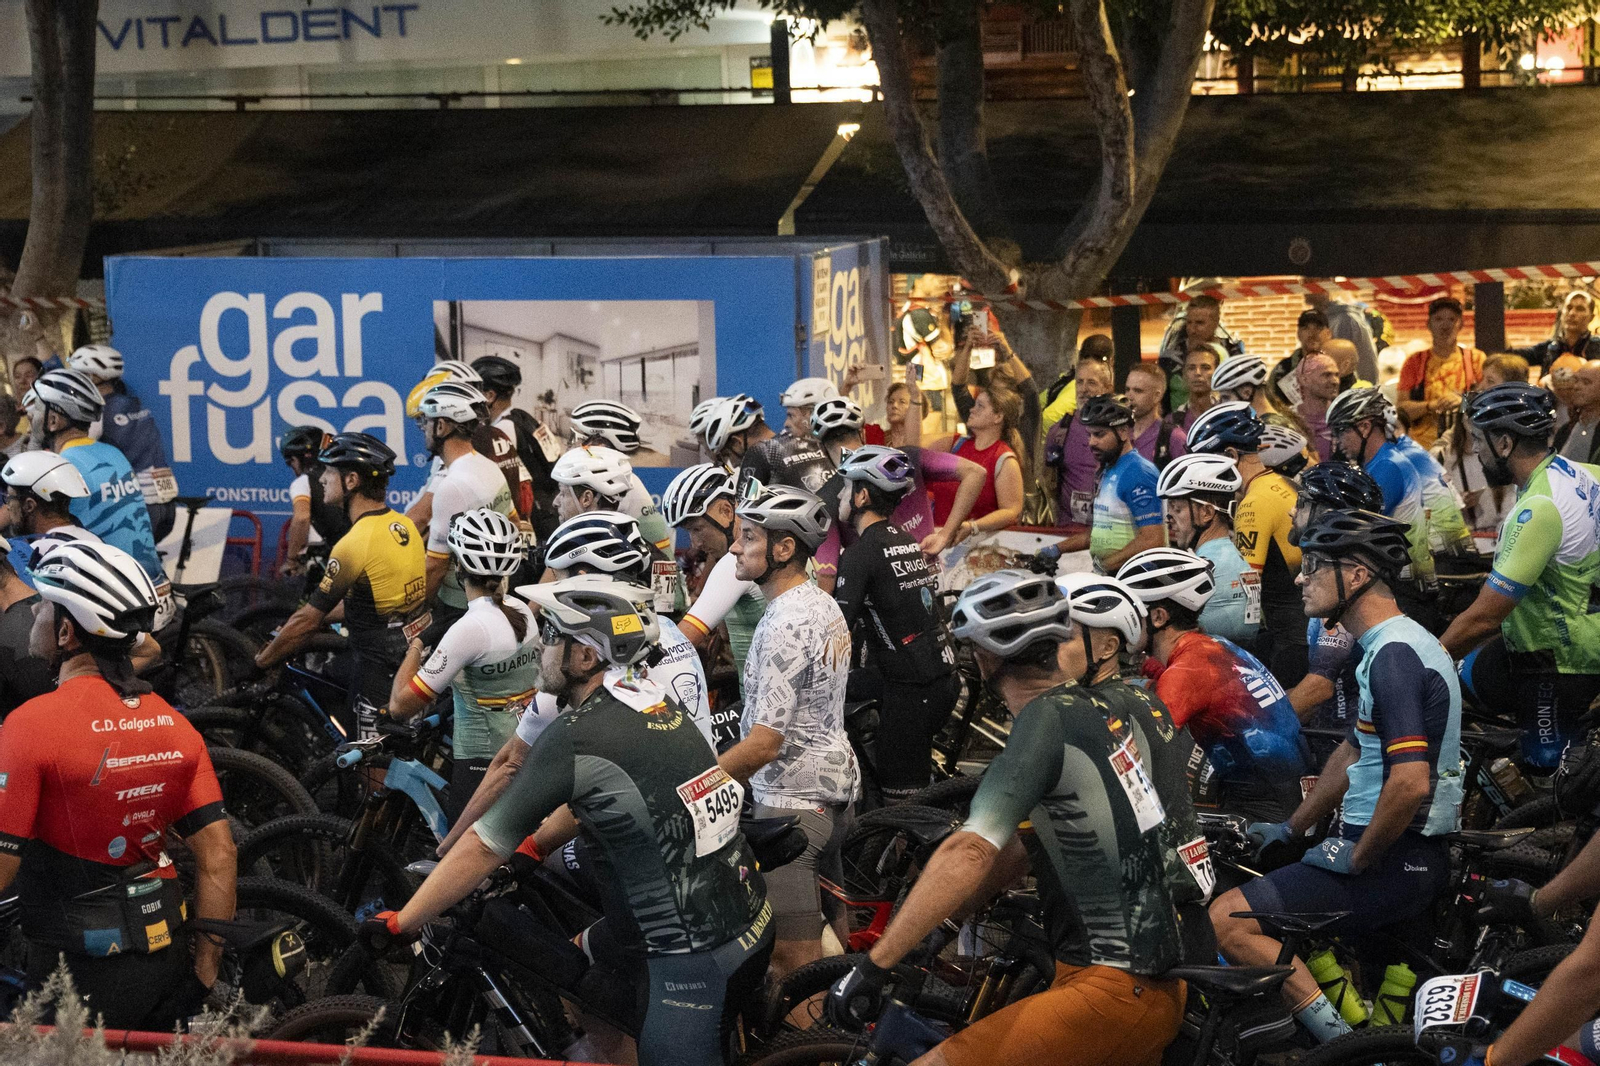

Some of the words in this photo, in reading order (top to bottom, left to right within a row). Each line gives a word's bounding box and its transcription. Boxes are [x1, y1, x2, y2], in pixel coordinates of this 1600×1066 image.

[97, 5, 417, 50] VITALDENT
[200, 291, 383, 407] gar
[159, 345, 408, 465] fusa
[1188, 479, 1234, 491] S-WORKS
[119, 717, 156, 732] Galgos
[157, 715, 174, 726] MTB
[1537, 682, 1554, 745] PROINTEC
[105, 750, 184, 768] SEFRAMA
[115, 783, 166, 801] TREK
[705, 783, 740, 824] 5495
[738, 931, 758, 951] LA
[1423, 985, 1457, 1026] 6332
